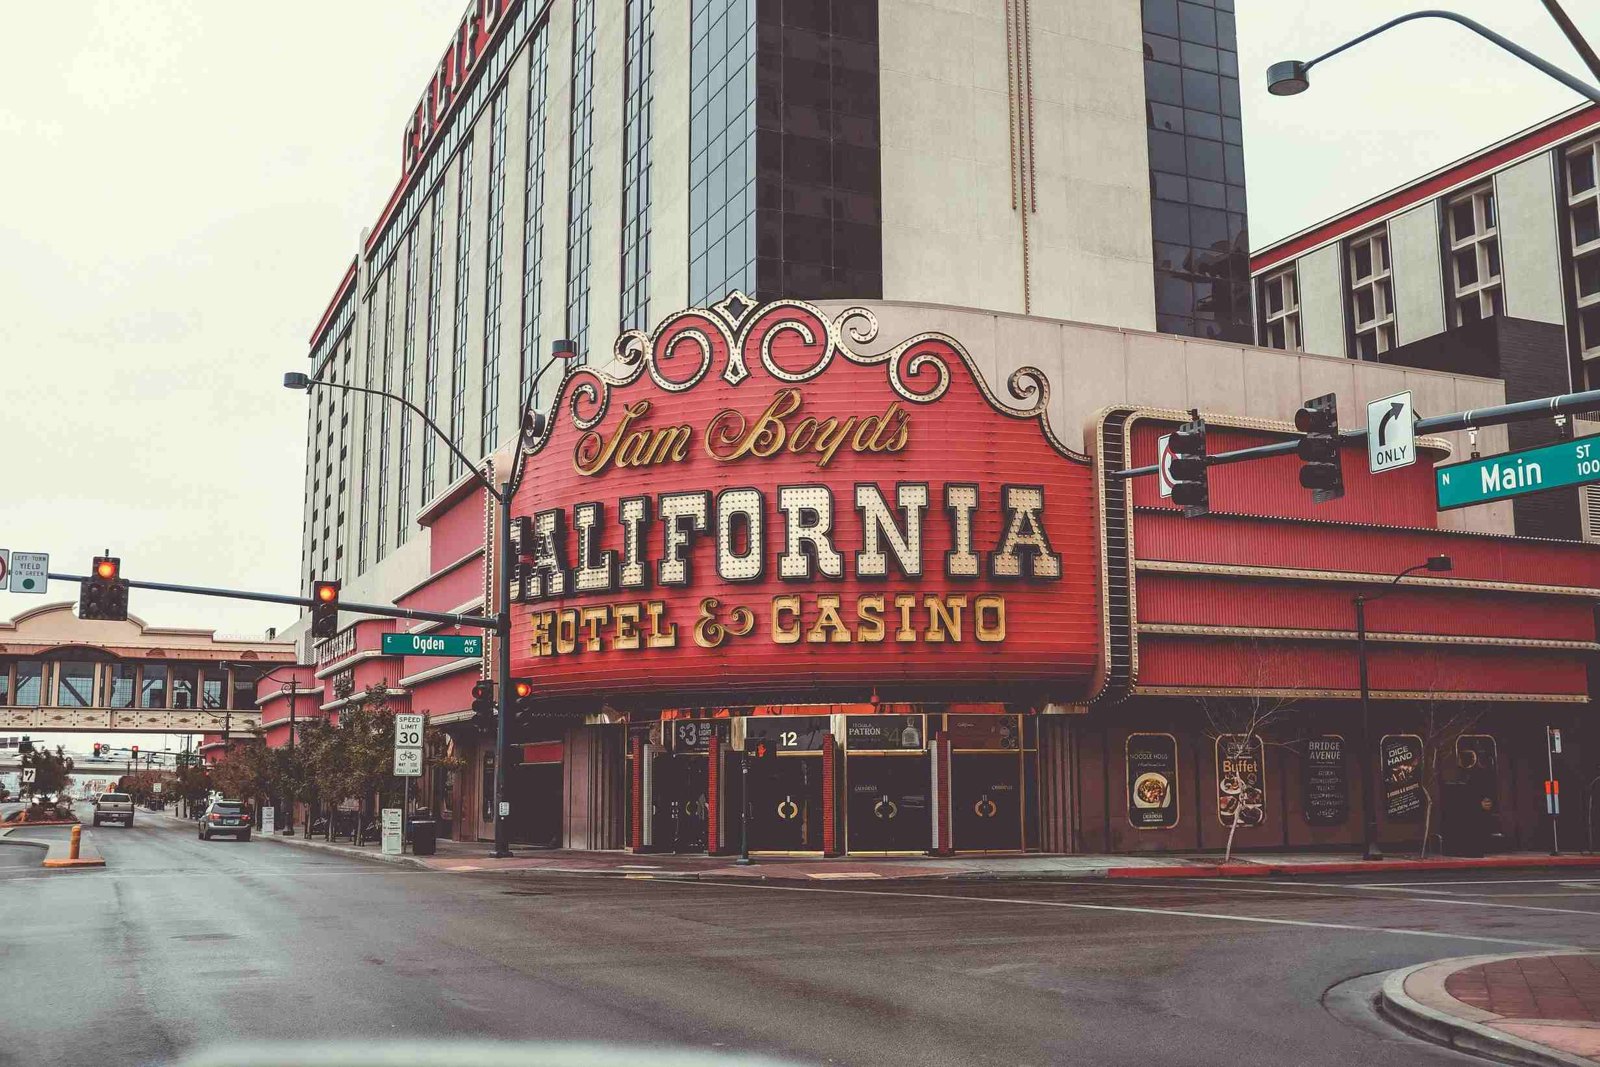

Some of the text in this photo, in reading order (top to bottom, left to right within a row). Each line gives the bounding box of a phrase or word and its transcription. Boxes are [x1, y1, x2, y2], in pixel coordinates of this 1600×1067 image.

[573, 387, 912, 476] Sam Boyd's
[1376, 445, 1407, 466] ONLY
[1442, 444, 1591, 494] N Main ST
[1577, 459, 1600, 476] 100
[530, 594, 1007, 658] HOTEL & CASINO
[412, 635, 445, 654] Ogden
[399, 732, 420, 744] 30
[678, 722, 697, 746] $3
[779, 731, 798, 747] 12
[1308, 741, 1341, 751] BRIDGE
[1388, 745, 1409, 758] DICE
[1309, 751, 1341, 760] AVENUE
[1387, 752, 1413, 766] HAND
[1222, 760, 1258, 773] Buffet
